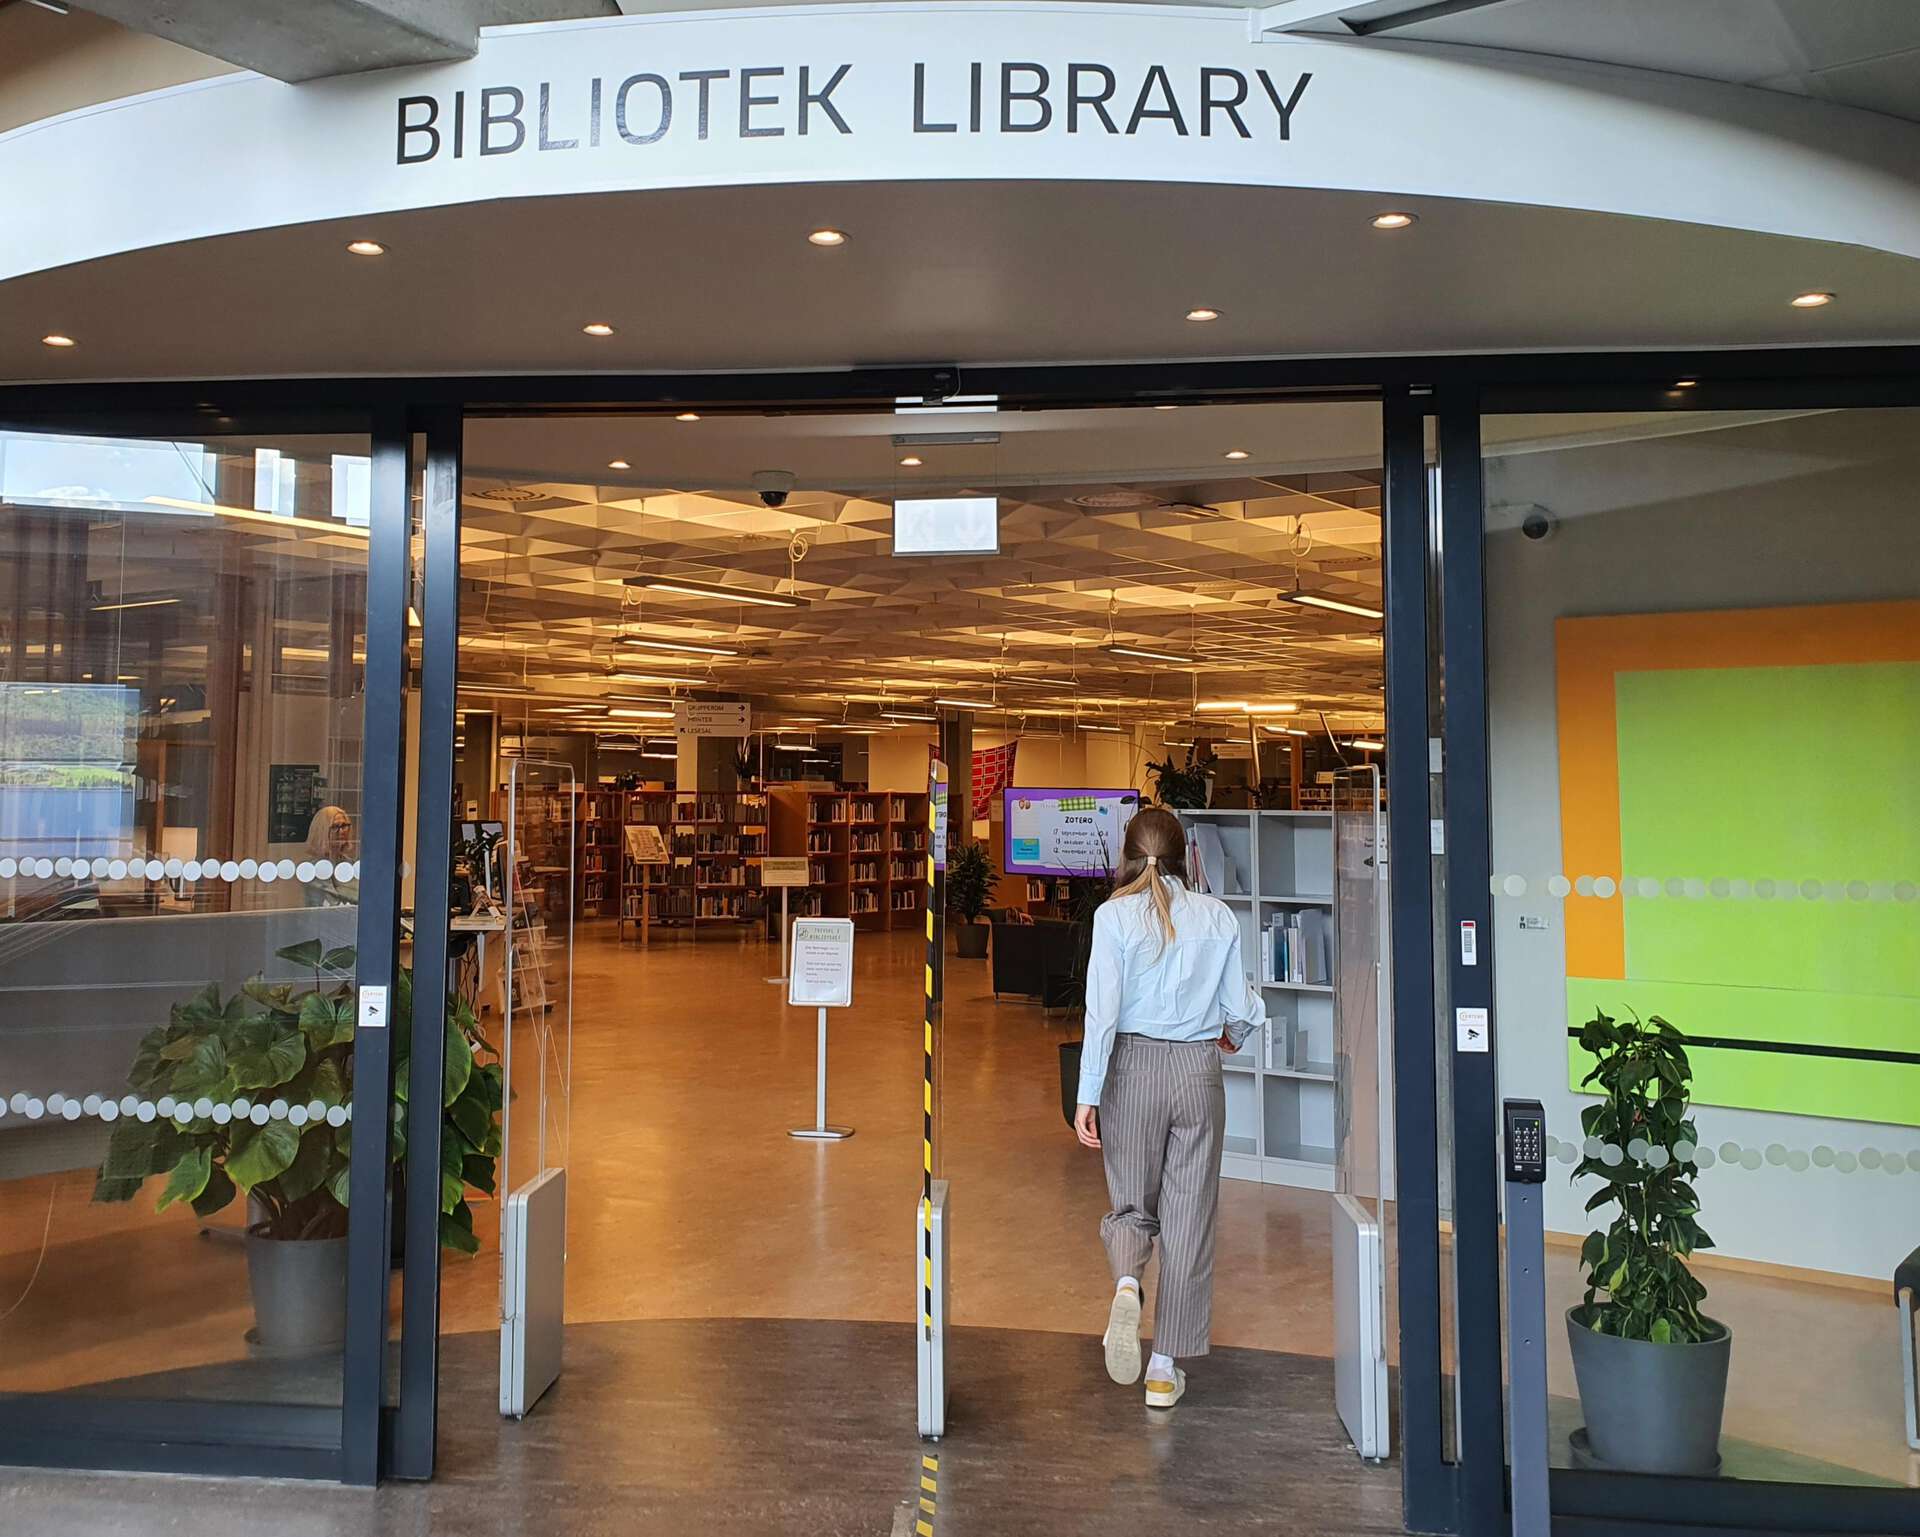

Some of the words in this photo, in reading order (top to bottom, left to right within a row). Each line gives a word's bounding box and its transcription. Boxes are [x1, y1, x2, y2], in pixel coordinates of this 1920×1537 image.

[396, 64, 852, 166] BIBLIOTEK
[914, 62, 1313, 142] LIBRARY
[1065, 816, 1093, 824] ZOTERO
